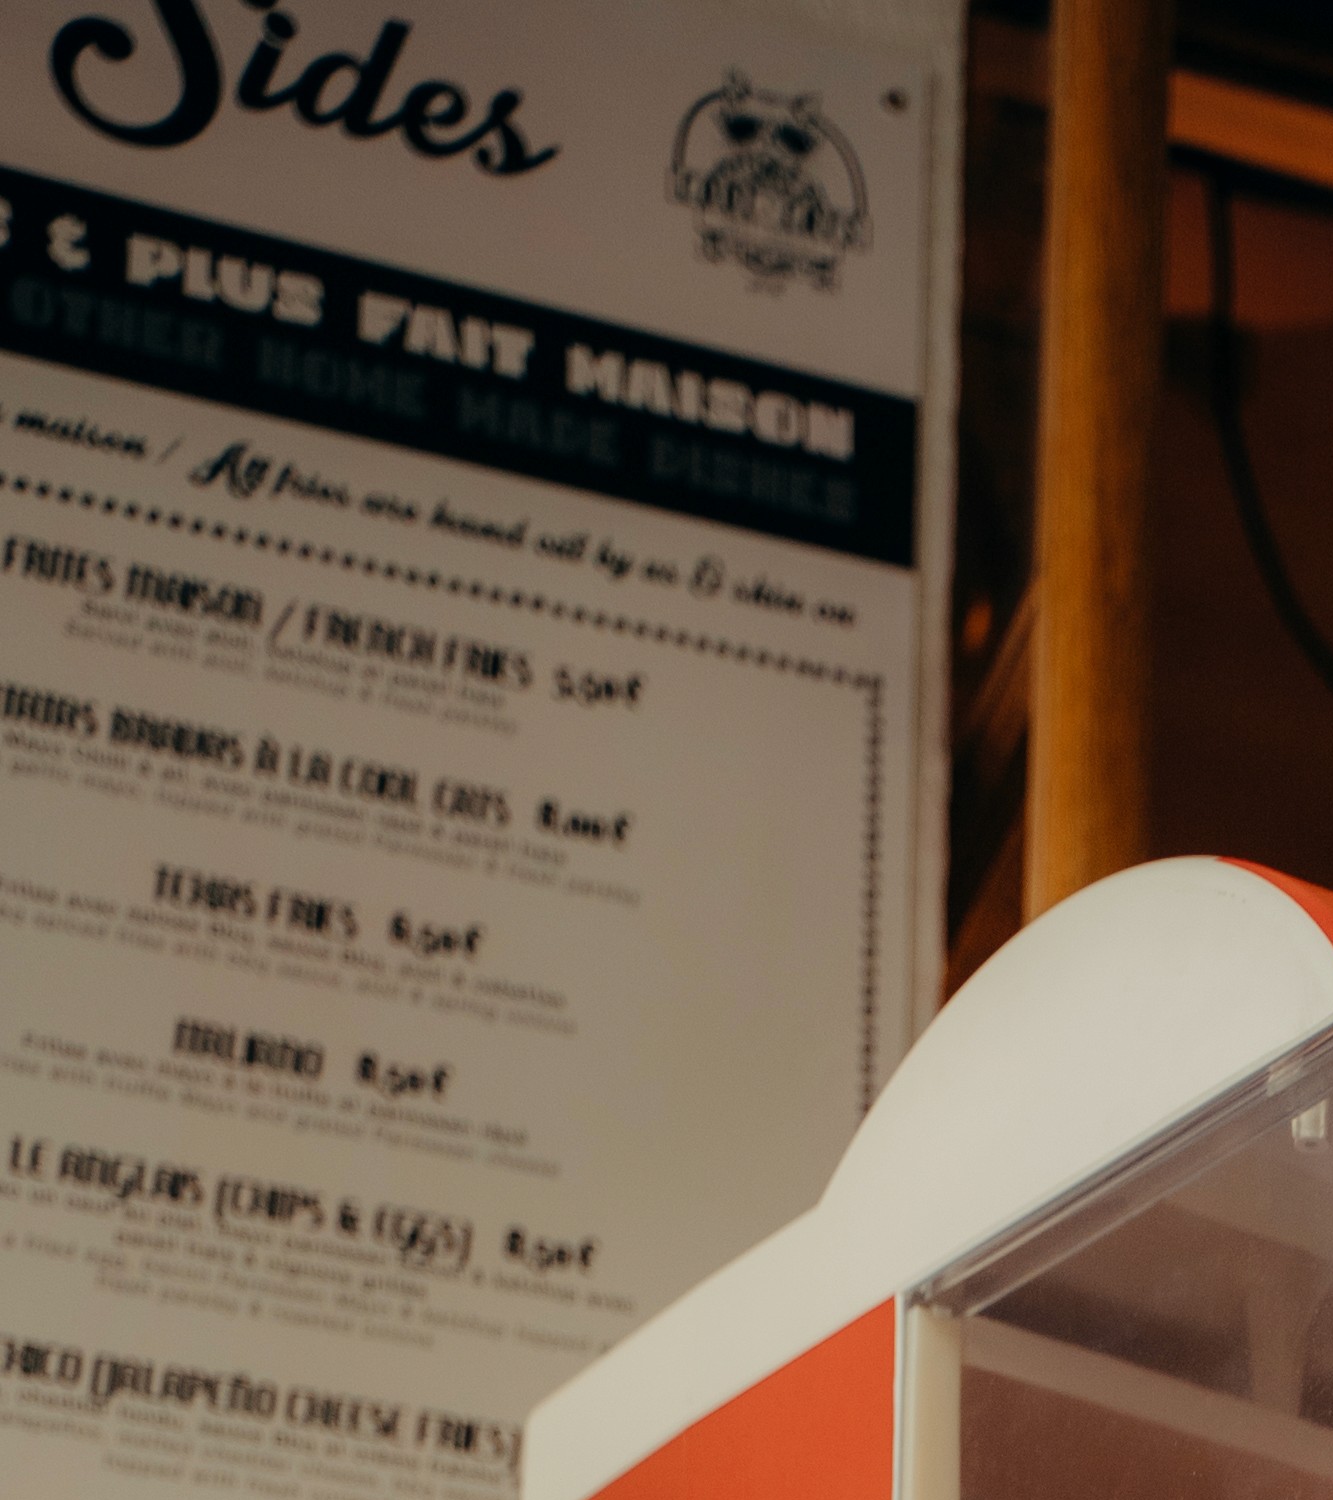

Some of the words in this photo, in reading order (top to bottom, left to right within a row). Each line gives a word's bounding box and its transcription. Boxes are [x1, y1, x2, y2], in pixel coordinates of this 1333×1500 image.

[124, 230, 325, 330] PLUS
[355, 287, 537, 381] FAIT
[563, 340, 856, 464] MAISON
